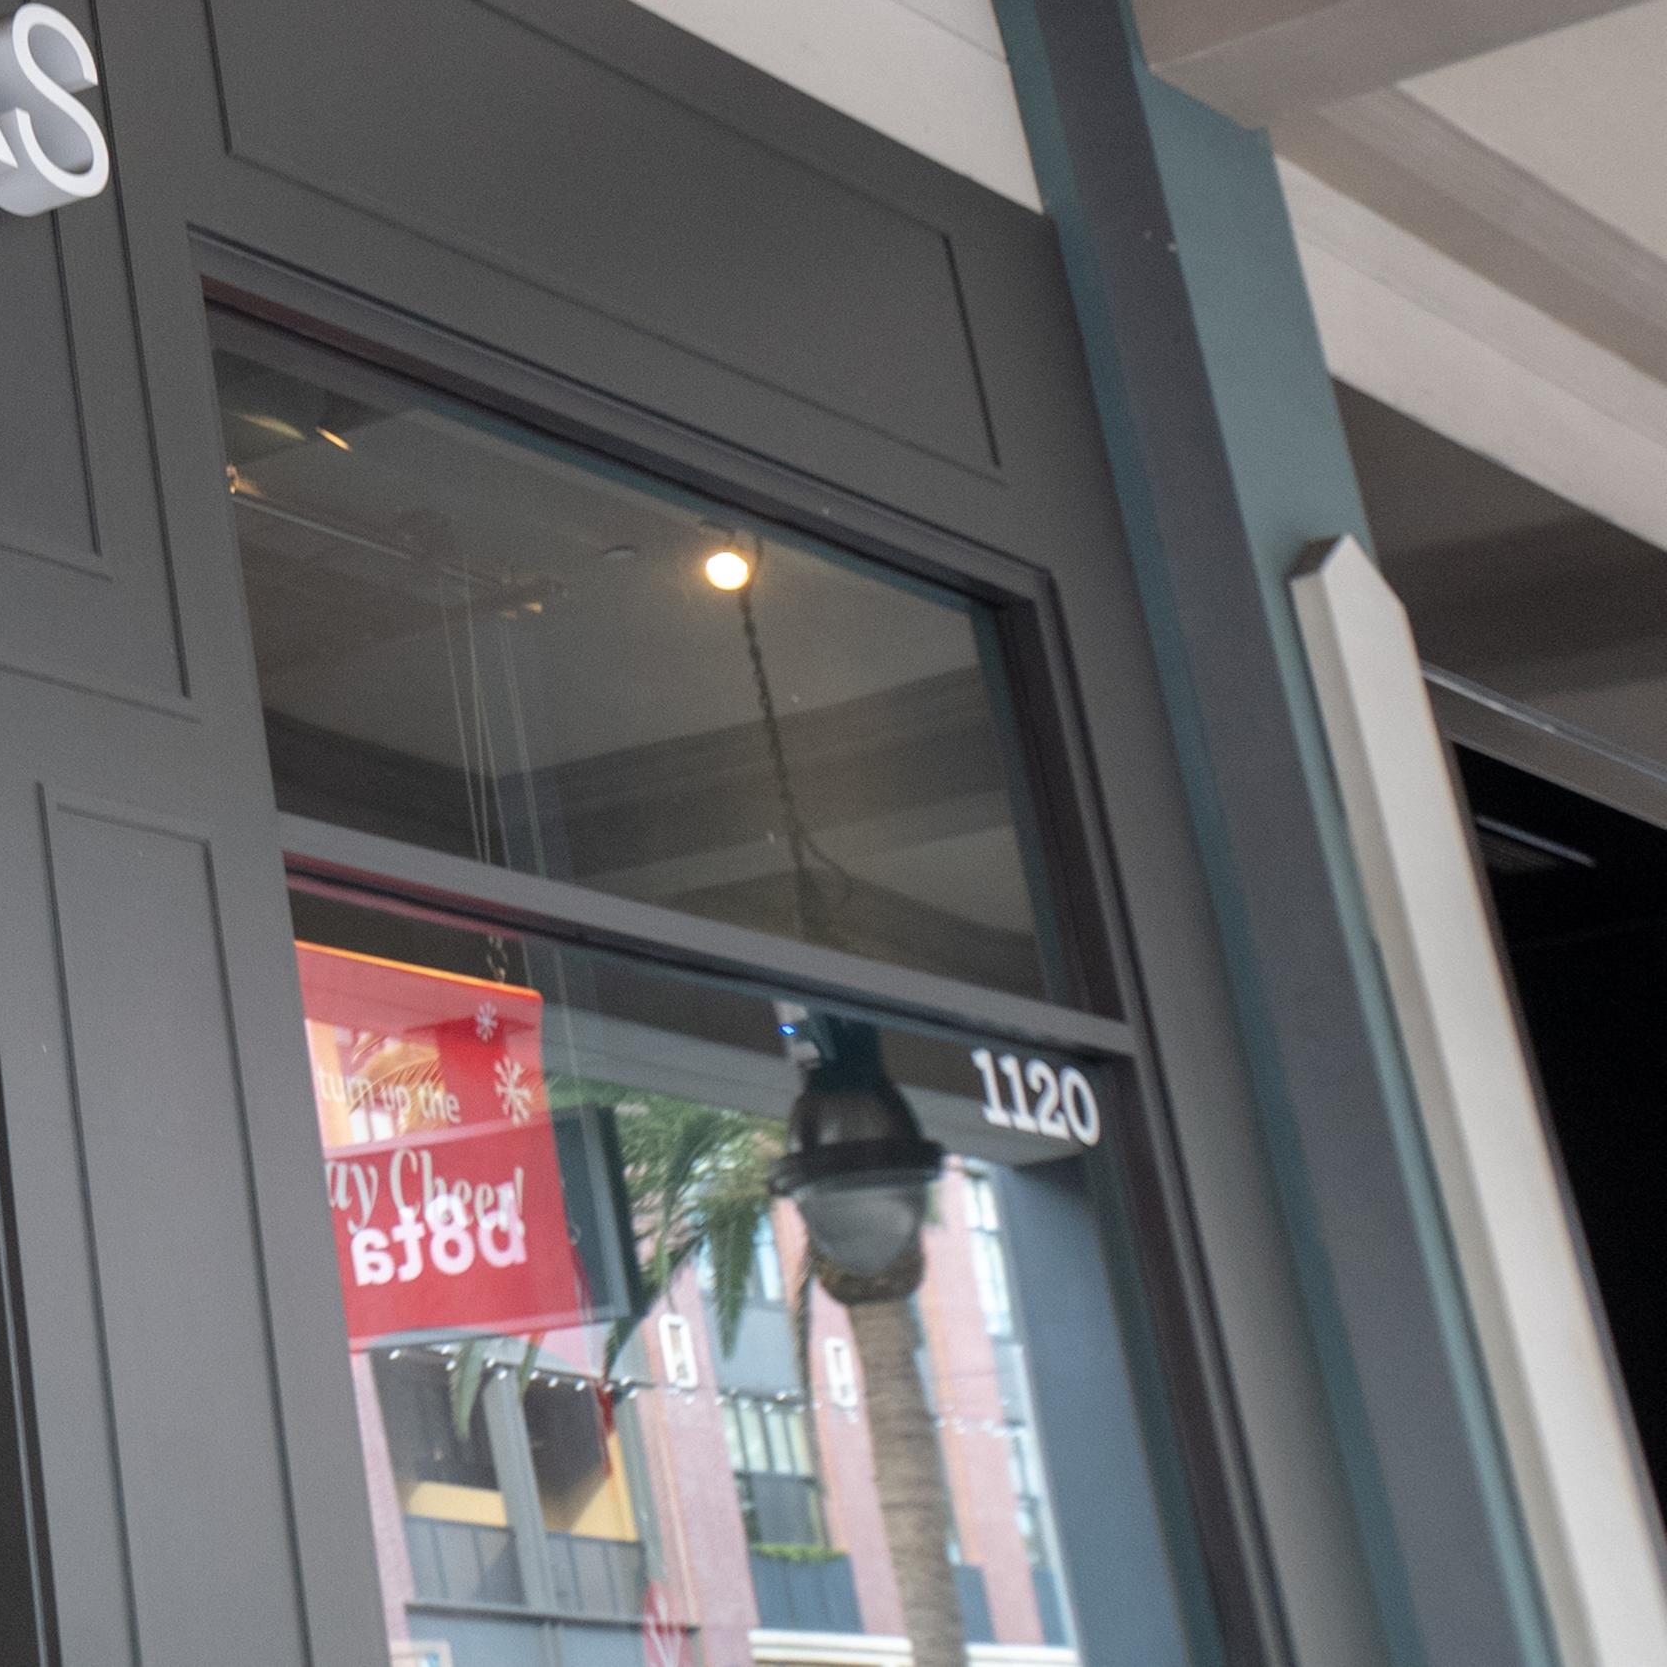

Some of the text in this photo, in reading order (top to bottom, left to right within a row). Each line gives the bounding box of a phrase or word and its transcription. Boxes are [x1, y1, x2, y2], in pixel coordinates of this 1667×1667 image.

[318, 1066, 462, 1134] turn up the
[971, 1047, 1101, 1146] 1120
